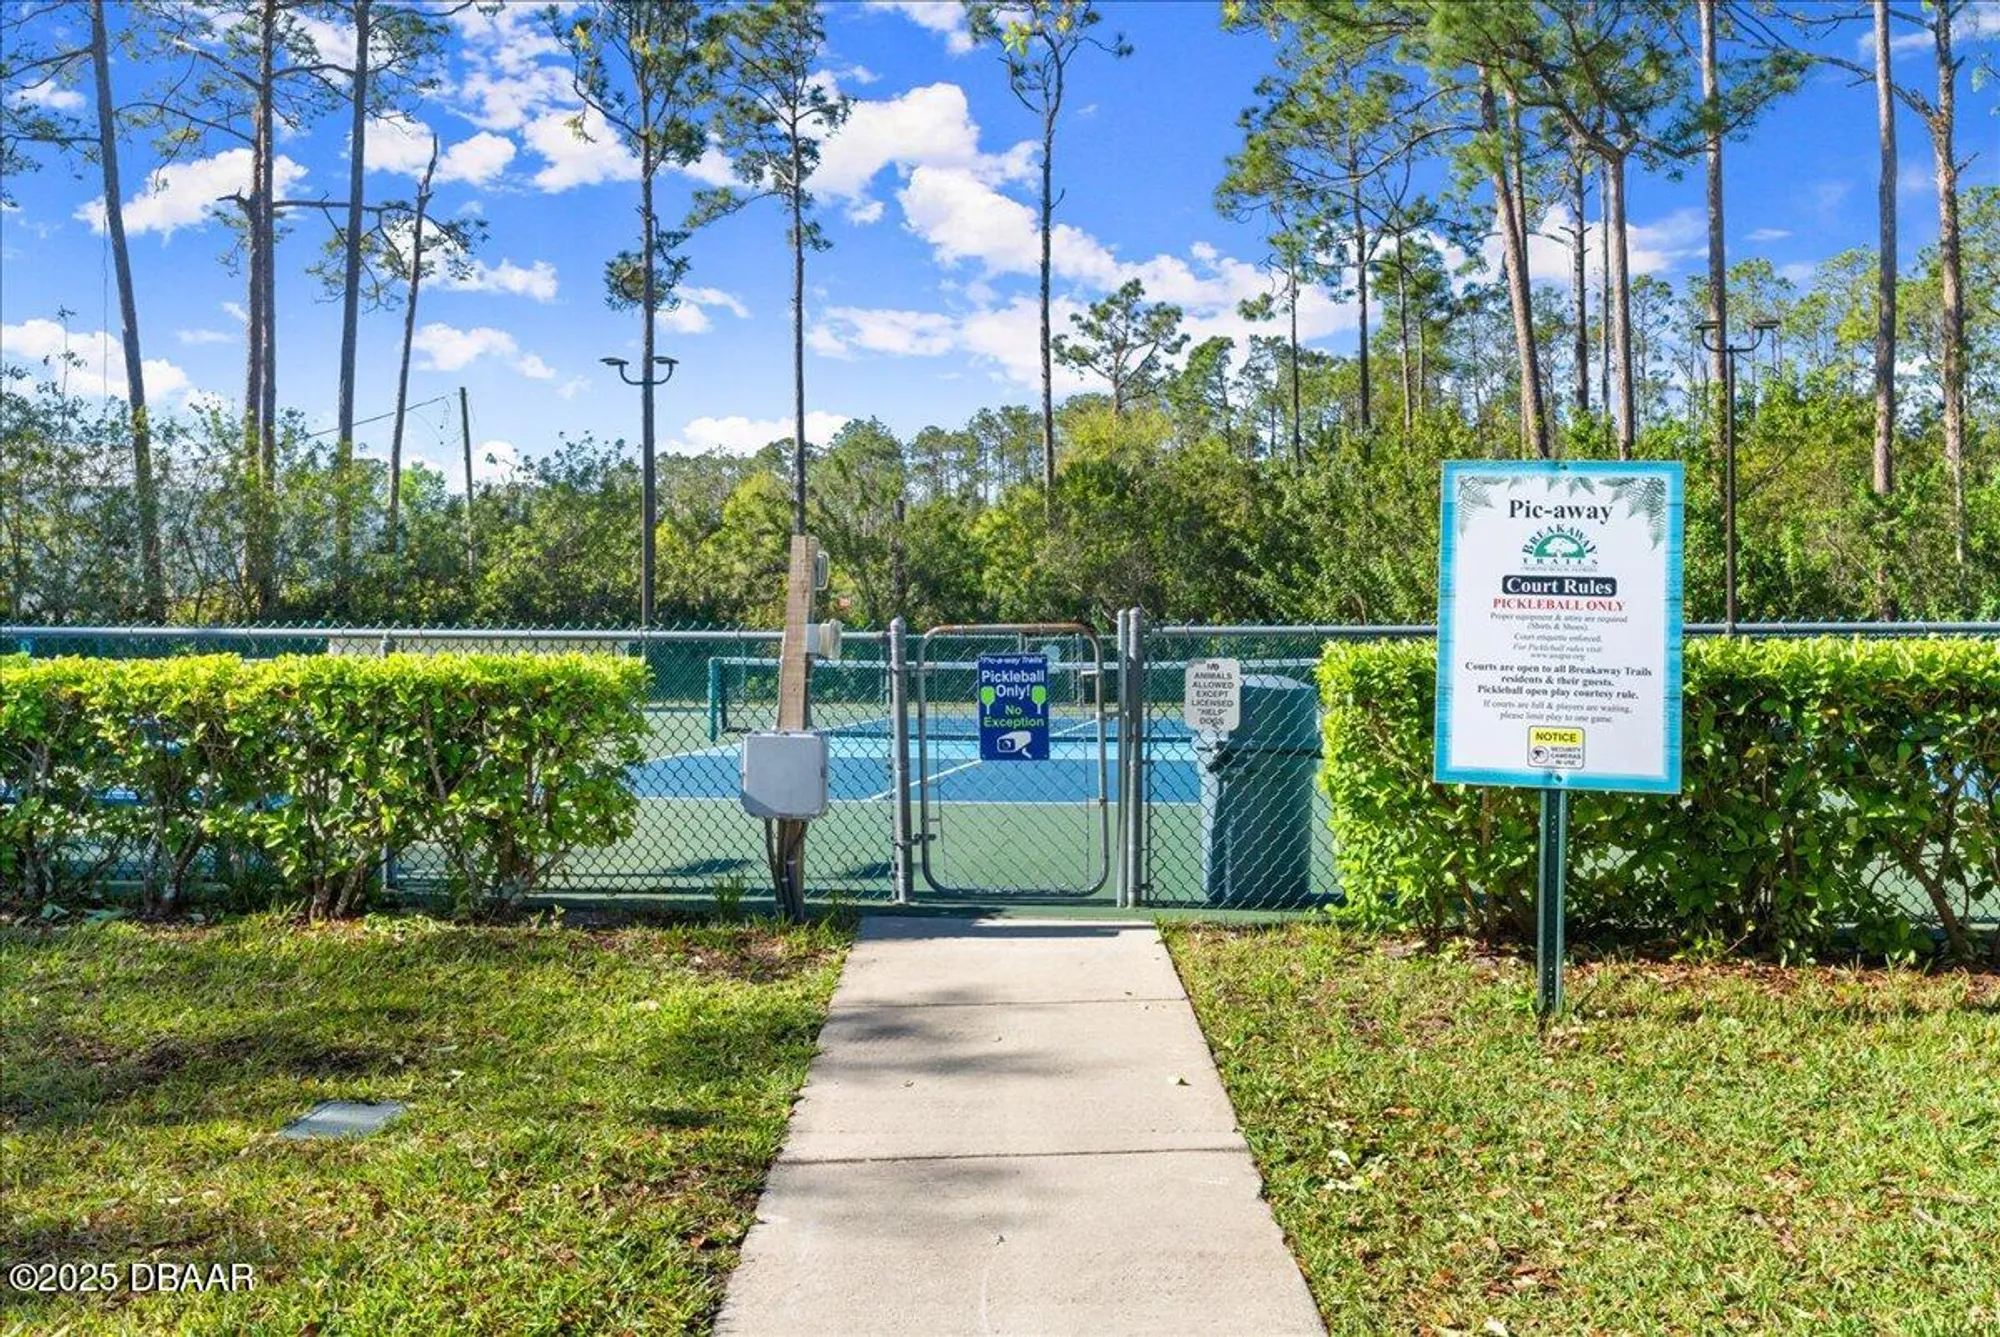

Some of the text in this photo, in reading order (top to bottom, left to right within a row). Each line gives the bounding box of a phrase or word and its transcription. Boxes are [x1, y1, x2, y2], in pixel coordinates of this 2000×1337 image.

[1509, 499, 1613, 524] Pic-away
[1522, 524, 1598, 554] BREAKAWAY
[1507, 577, 1612, 595] Court Rules
[1493, 598, 1626, 612] PICKLEBALL ONLY
[1490, 612, 1514, 622] Proper
[1516, 614, 1552, 622] equipment
[1597, 616, 1628, 624] required
[1514, 632, 1534, 640] Court
[1528, 644, 1564, 652] Pickleball
[1465, 662, 1496, 670] Courts
[1517, 665, 1539, 674] open
[1569, 665, 1621, 676] Breakaway
[1624, 667, 1652, 676] Trails
[982, 670, 1044, 683] Pickleball
[1502, 675, 1542, 683] residents
[1545, 676, 1554, 684] &
[1582, 679, 1614, 687] guests.
[996, 684, 1030, 700] Only!
[1478, 685, 1639, 700] Pickleball open play courtesy rule.
[1005, 705, 1022, 715] No
[1556, 704, 1584, 712] players
[1200, 717, 1224, 725] DOGS
[1500, 711, 1524, 720] please
[1546, 713, 1563, 722] play
[984, 717, 1044, 729] Exception
[1535, 732, 1577, 742] NOTICE
